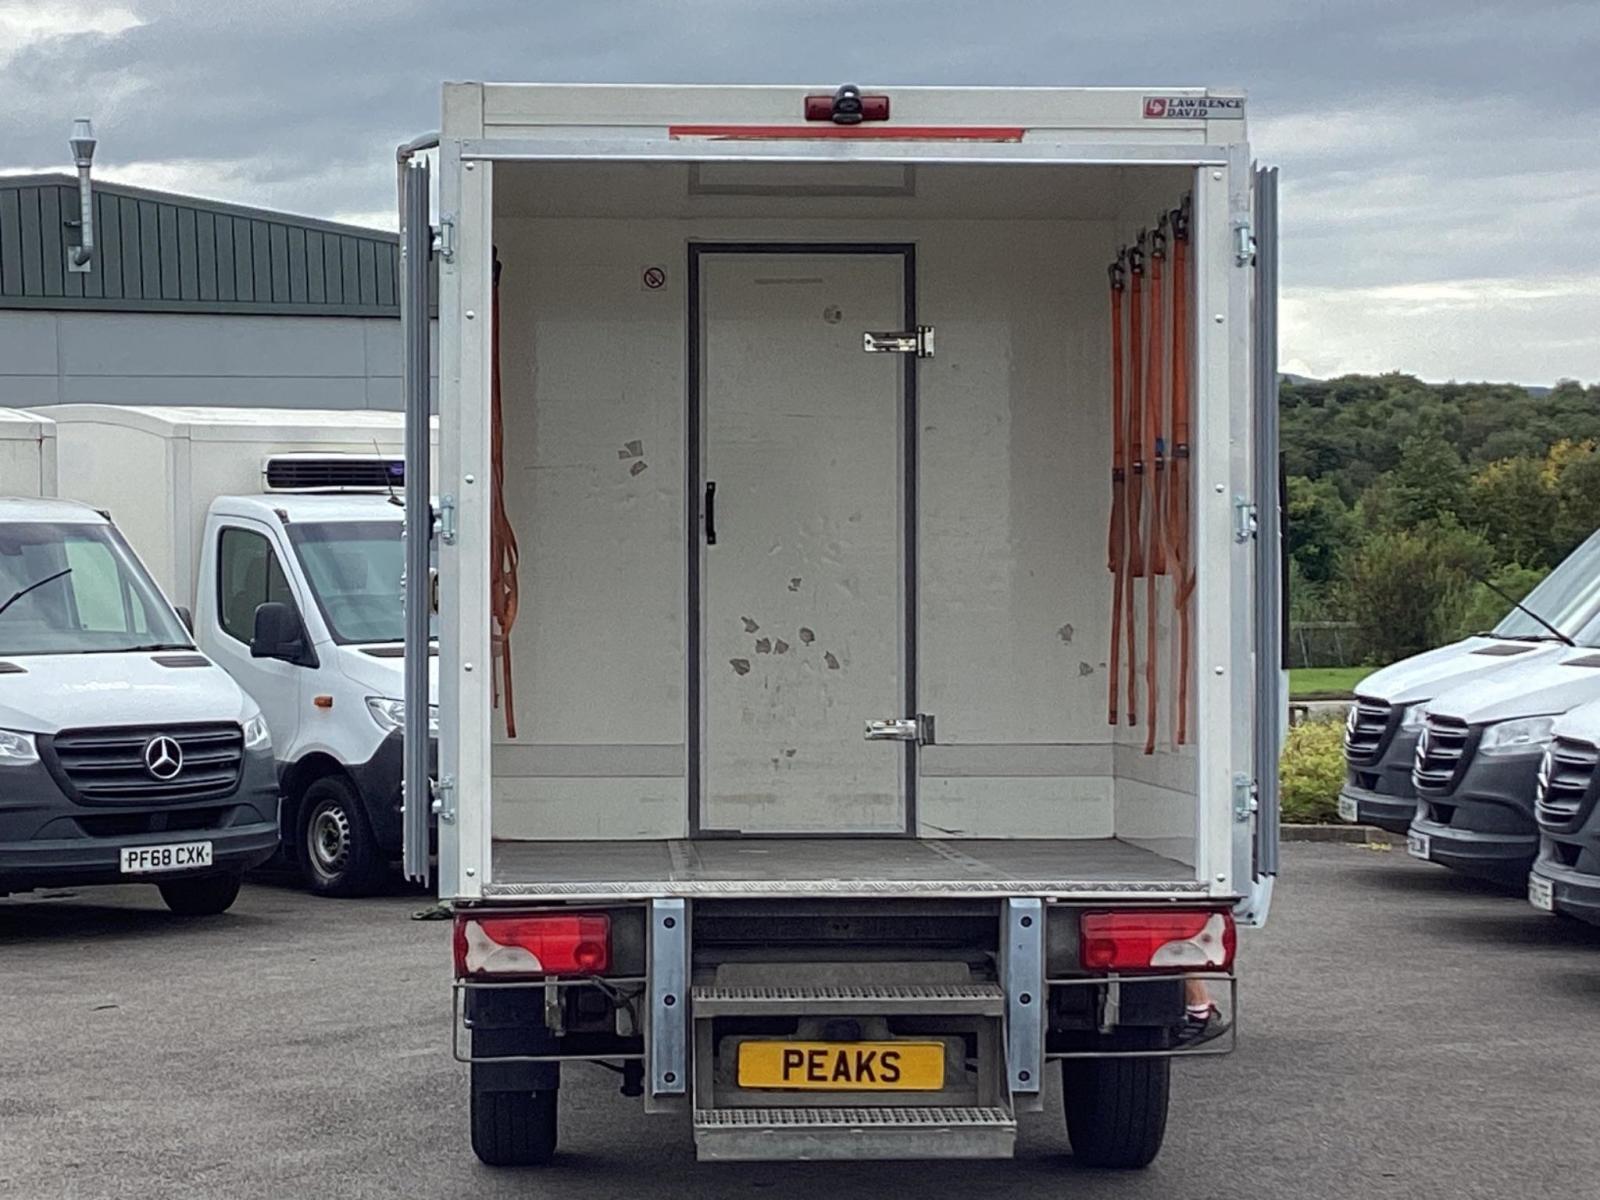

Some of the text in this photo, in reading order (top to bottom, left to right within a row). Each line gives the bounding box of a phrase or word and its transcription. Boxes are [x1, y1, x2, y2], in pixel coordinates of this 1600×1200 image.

[1168, 99, 1242, 108] LAWRENCE
[1167, 108, 1208, 117] DAVID
[128, 846, 205, 868] PF68 CXK
[783, 1049, 901, 1082] PEAKS
